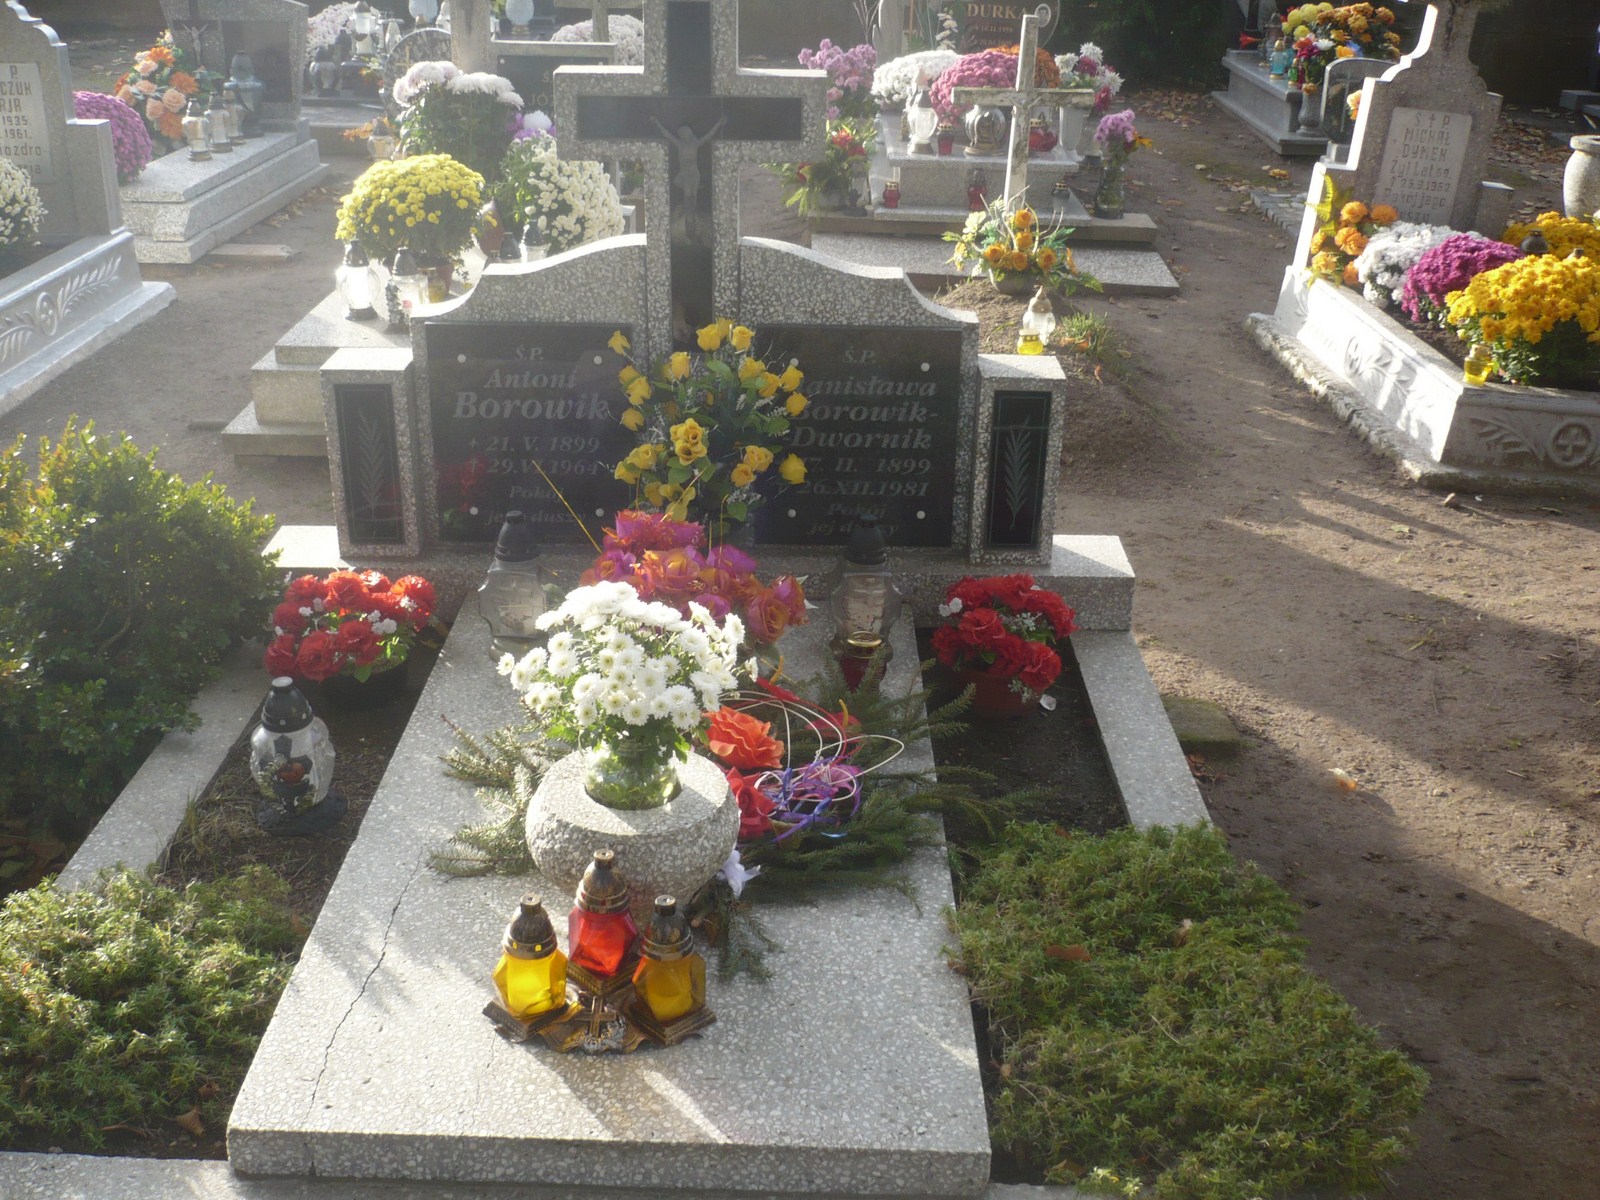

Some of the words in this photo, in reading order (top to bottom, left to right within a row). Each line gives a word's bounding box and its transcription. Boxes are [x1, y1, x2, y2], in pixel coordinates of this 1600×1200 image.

[484, 369, 577, 389] Antoni
[799, 376, 938, 397] anisława
[452, 391, 609, 420] Borowik
[486, 436, 514, 452] 21.
[548, 436, 600, 453] 1899
[875, 458, 932, 475] 1899
